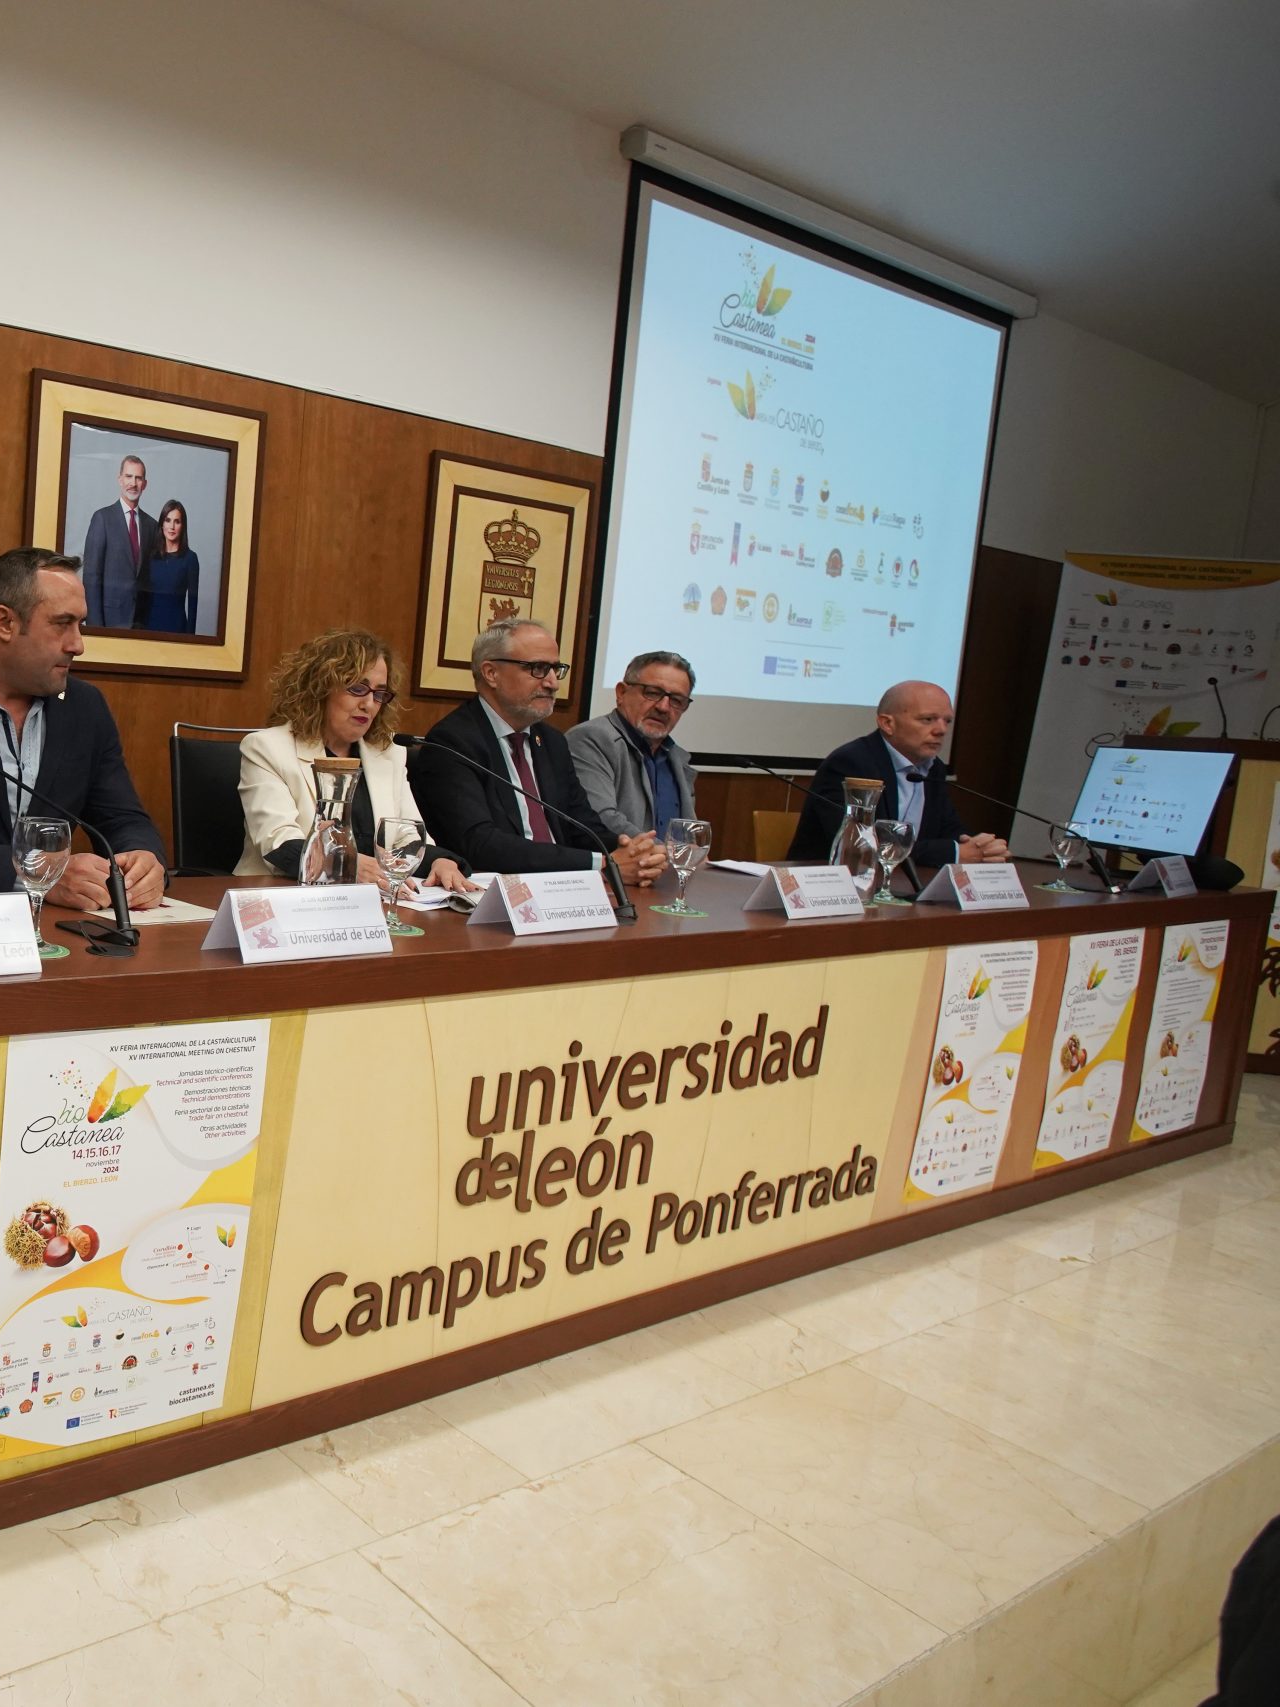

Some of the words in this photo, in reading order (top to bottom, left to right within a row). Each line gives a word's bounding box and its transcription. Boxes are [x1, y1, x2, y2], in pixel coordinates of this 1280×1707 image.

[719, 293, 776, 339] Castanea
[776, 408, 824, 439] CASTAÑO
[544, 907, 586, 920] Universidad
[587, 907, 596, 917] de
[597, 906, 611, 916] León
[289, 931, 348, 945] Universidad
[351, 929, 362, 940] de
[364, 928, 387, 939] León
[3, 944, 34, 959] León
[139, 1041, 187, 1049] INTERNACIONAL
[206, 1036, 256, 1045] CASTAÑICULTURA
[138, 1051, 186, 1059] INTERNATIONAL
[225, 1045, 255, 1053] CHESTNUT
[465, 1004, 830, 1138] universidad
[56, 1098, 87, 1126] bio
[20, 1115, 124, 1154] Castanea
[72, 1144, 122, 1160] 14.15.16.17
[85, 1157, 120, 1168] noviembre
[102, 1166, 119, 1174] 2024
[299, 1235, 548, 1348] Campus
[565, 1207, 631, 1276] de
[646, 1144, 879, 1255] Ponferrada
[178, 1383, 215, 1396] castanea.es
[168, 1390, 215, 1406] biocastanea.es
